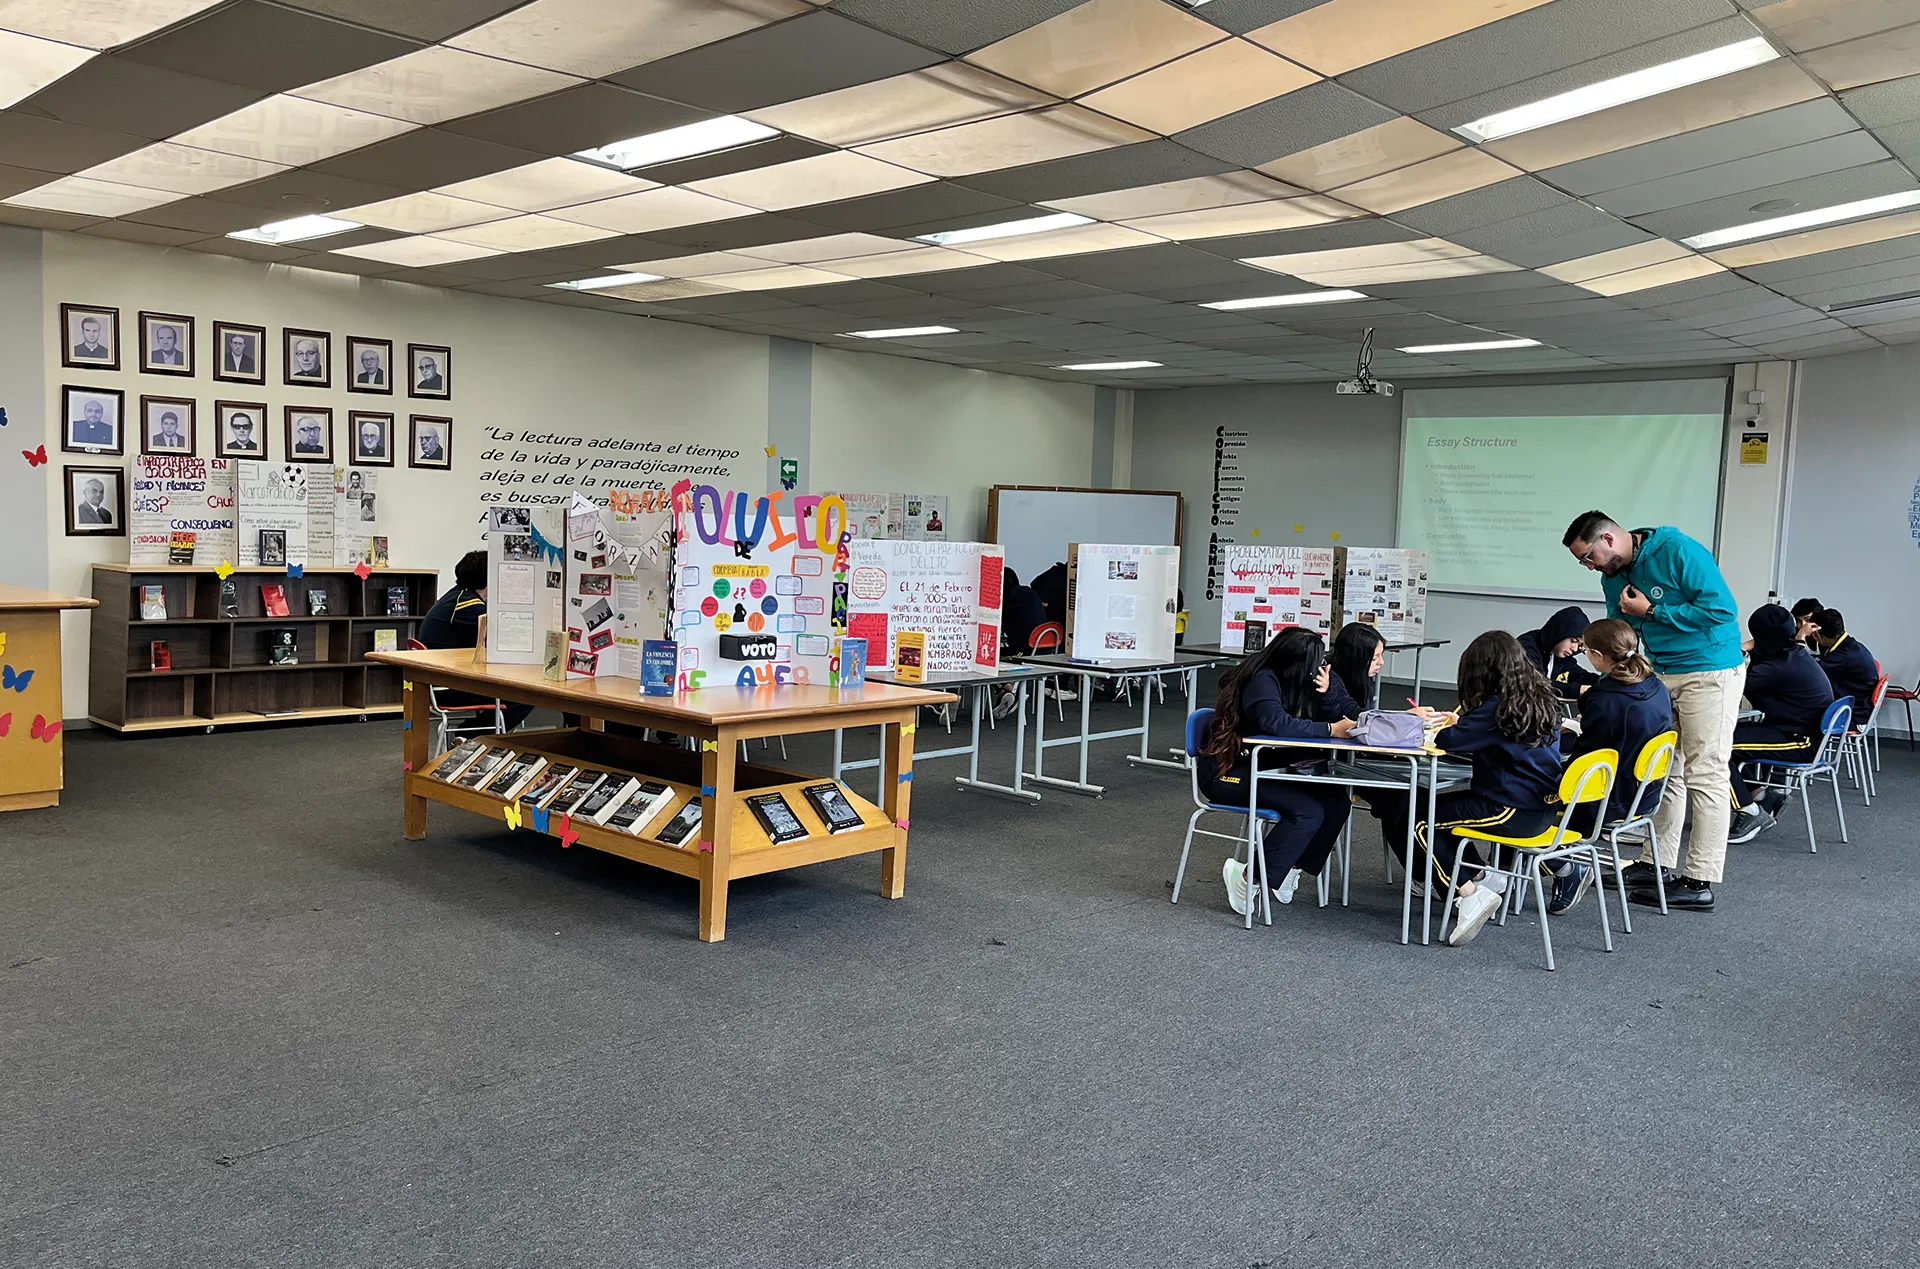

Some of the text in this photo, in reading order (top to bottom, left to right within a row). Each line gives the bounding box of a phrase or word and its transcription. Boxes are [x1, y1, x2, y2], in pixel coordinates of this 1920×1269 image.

[520, 431, 583, 447] lectura
[588, 437, 662, 453] adelanta
[666, 443, 682, 455] el
[685, 445, 740, 461] tiempo
[1427, 437, 1517, 449] Essay Structure
[211, 459, 227, 469] EN
[480, 449, 731, 478] de la vida y paradójicamente,
[145, 467, 207, 479] COLOMBIA
[479, 469, 525, 486] aleja
[531, 472, 549, 485] el
[552, 473, 575, 487] de
[580, 474, 595, 488] la
[601, 478, 666, 493] muerte.
[480, 491, 502, 503] es
[508, 492, 570, 505] buscar
[1426, 532, 1467, 540] Conclusion
[734, 541, 754, 560] DE
[894, 543, 921, 556] DONDE
[925, 543, 937, 555] LA
[938, 544, 951, 555] PAZ
[955, 544, 968, 554] FUE
[1288, 548, 1301, 559] DEL
[858, 552, 882, 560] Vereda
[911, 556, 950, 569] DELITO:
[916, 582, 925, 592] 21
[929, 582, 940, 593] de
[945, 582, 972, 592] Febrero
[906, 593, 917, 603] de
[924, 593, 947, 604] 2005
[912, 604, 921, 612] de
[741, 643, 776, 657] VOTO
[735, 664, 811, 687] AYER
